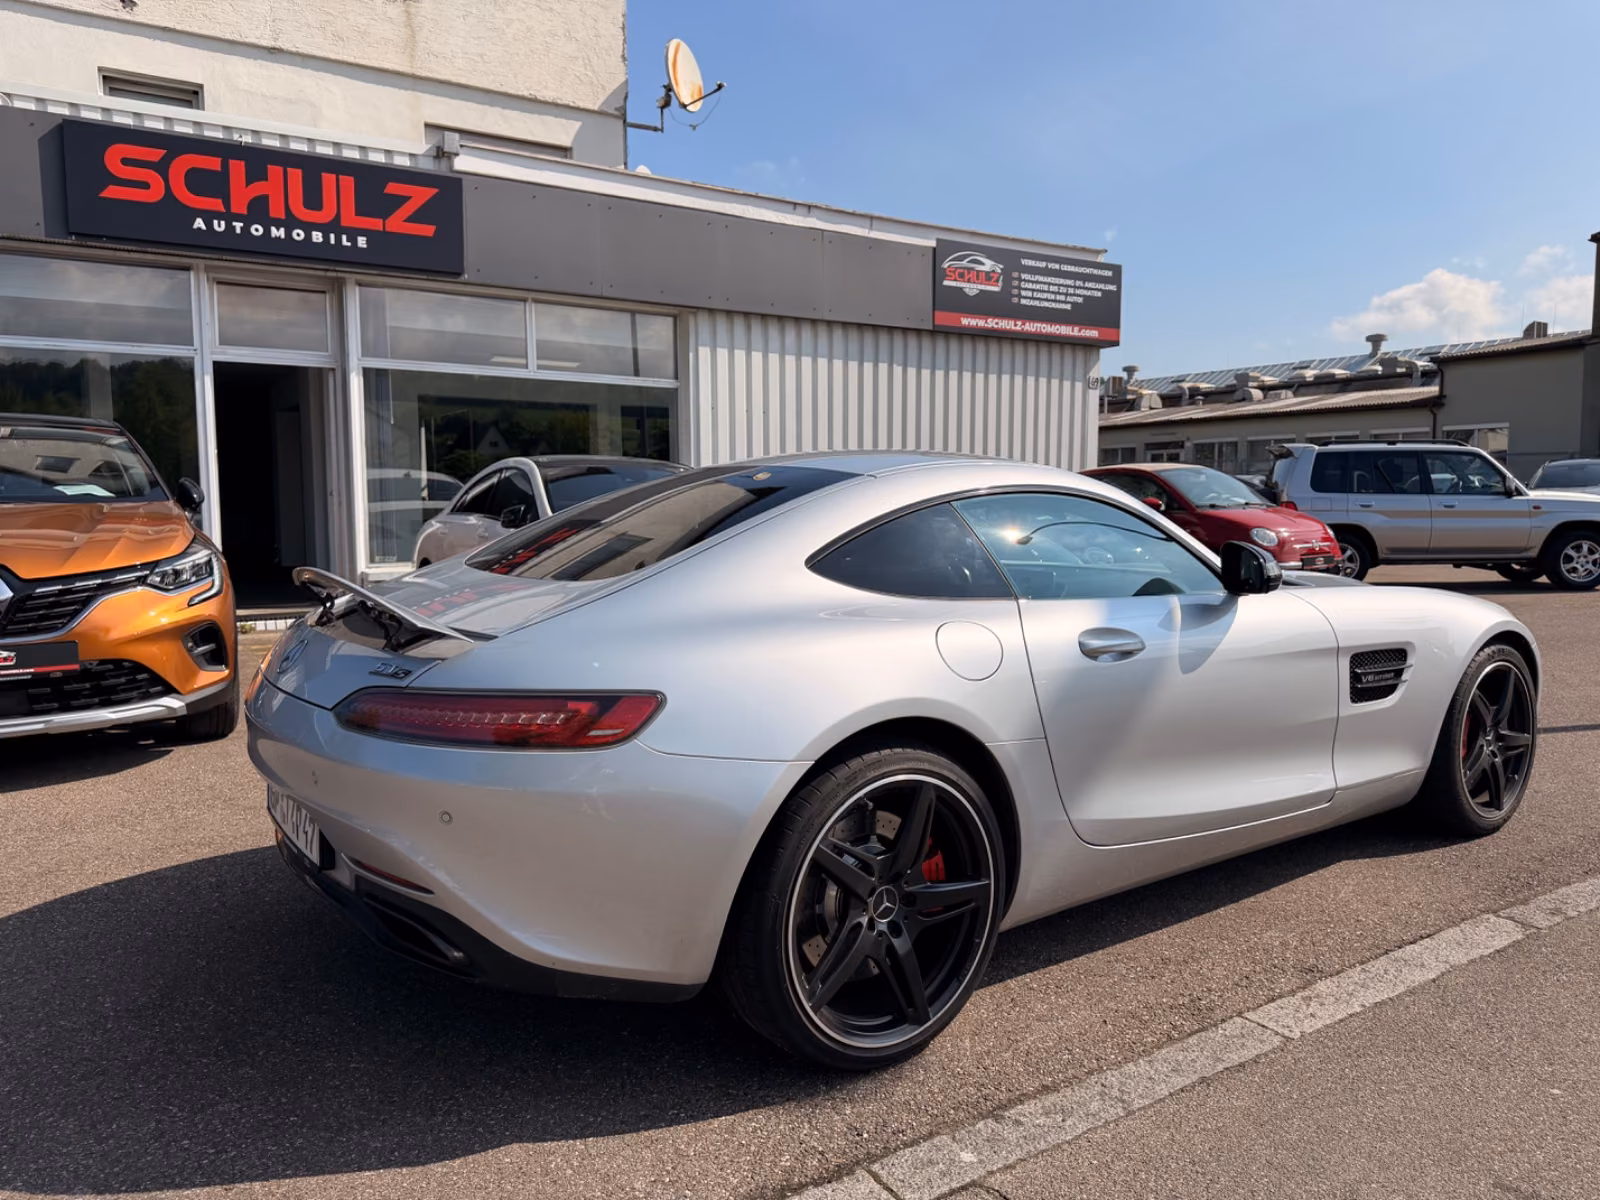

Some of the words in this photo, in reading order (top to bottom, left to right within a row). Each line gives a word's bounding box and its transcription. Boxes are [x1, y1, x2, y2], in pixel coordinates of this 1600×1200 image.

[99, 143, 439, 237] SCHULZ
[192, 217, 368, 249] AUTOMOBILE
[1021, 258, 1046, 268] VERKAUF
[1048, 262, 1060, 270] VON
[945, 267, 1000, 287] SCHULZ
[960, 316, 1099, 338] www.SCHULZ-AUTOMOBILE.com
